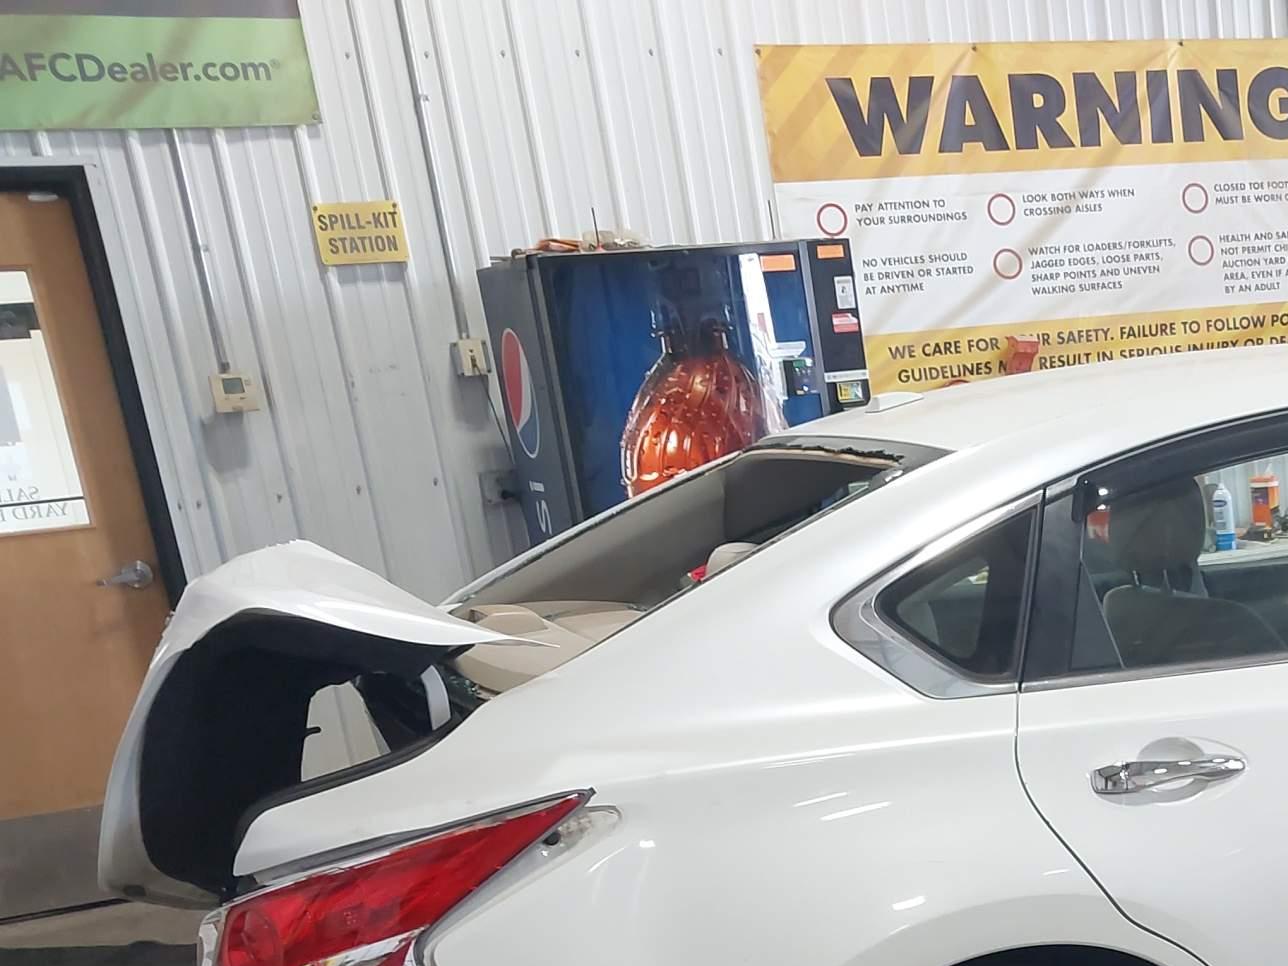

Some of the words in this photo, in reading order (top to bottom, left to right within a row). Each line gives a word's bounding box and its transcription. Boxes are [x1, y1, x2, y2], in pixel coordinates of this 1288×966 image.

[1214, 182, 1246, 193] CLOSED
[1249, 181, 1264, 191] TOE
[1022, 193, 1048, 203] LOOK
[1051, 191, 1076, 202] BOTH
[1078, 190, 1105, 200] WAYS
[1107, 188, 1135, 198] WHEN
[1215, 195, 1238, 205] MUST
[1242, 195, 1251, 204] BE
[1254, 193, 1282, 203] WORN
[855, 203, 873, 213] PAY
[878, 200, 930, 211] ATTENTION
[933, 199, 945, 208] TO
[1023, 205, 1072, 217] CROSSING
[1075, 203, 1103, 213] AISLES
[317, 211, 397, 231] SPILL-KIT
[856, 217, 885, 227] YOUR
[889, 212, 967, 225] SURROUNDINGS
[328, 235, 398, 254] STATION
[1219, 234, 1251, 243] HEALTH
[1254, 232, 1273, 241] AND
[1028, 246, 1060, 256] WATCH
[1064, 244, 1080, 254] FOR
[1083, 238, 1176, 252] LOADERS/FORKLIFTS,
[1221, 246, 1239, 256] NOT
[1242, 244, 1271, 254] PERMIT
[862, 259, 877, 268] NO
[881, 255, 925, 266] VEHICLES
[928, 252, 967, 263] SHOULD
[1031, 259, 1065, 269] JAGGED
[1102, 254, 1131, 264] LOOSE
[1133, 252, 1163, 262] PARTS,
[1222, 257, 1261, 268] AUCTION
[1264, 256, 1286, 266] YARD
[864, 272, 874, 281] BE
[878, 269, 914, 280] DRIVEN
[918, 268, 932, 277] OR
[935, 266, 974, 276] STARTED
[1031, 272, 1061, 282] SHARP
[1064, 270, 1097, 280] POINTS
[1100, 268, 1120, 278] AND
[1123, 265, 1160, 276] UNEVEN
[1251, 269, 1273, 279] EVEN
[1276, 268, 1282, 277] IF
[865, 287, 876, 295] AT
[880, 283, 924, 294] ANYTIME
[1032, 284, 1076, 296] WALKING
[1079, 281, 1123, 292] SURFACES
[1225, 284, 1235, 294] BY
[1238, 283, 1251, 292] AN
[1254, 281, 1280, 291] ADULT
[1056, 327, 1115, 345] SAFETY.
[1120, 323, 1176, 340] FAILURE
[1181, 321, 1200, 334] TO
[1206, 315, 1266, 332] FOLLOW
[888, 344, 915, 360] WE
[921, 340, 961, 357] CARE
[967, 337, 1000, 352] FOR
[1039, 353, 1091, 370] RESULT
[1097, 351, 1113, 362] IN
[898, 361, 992, 384] GUIDELINES
